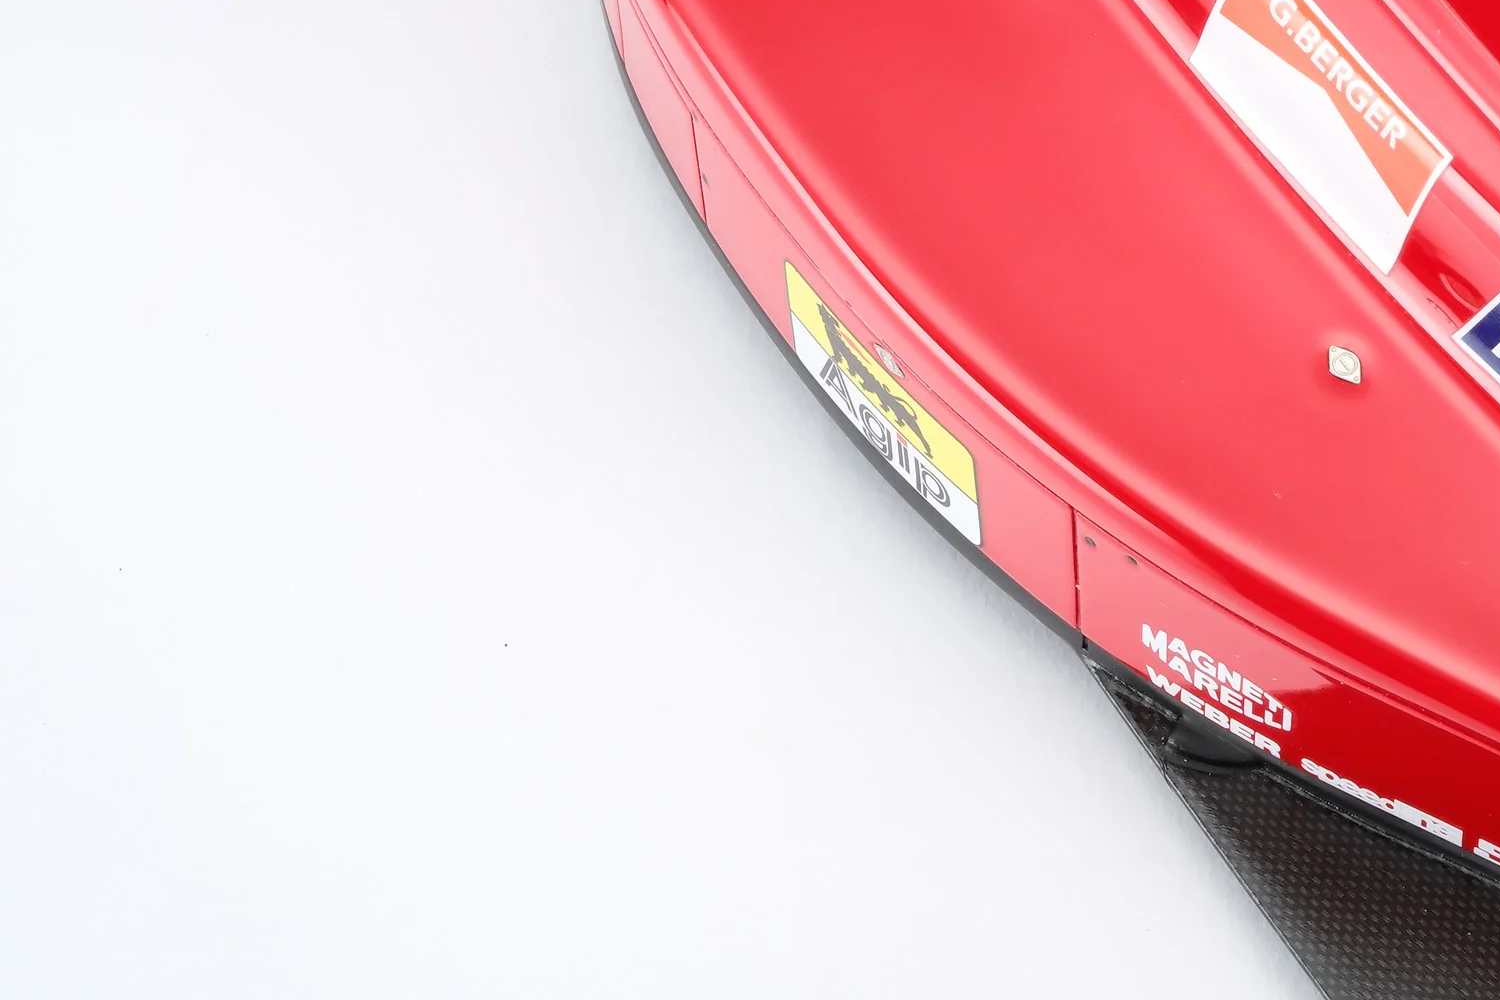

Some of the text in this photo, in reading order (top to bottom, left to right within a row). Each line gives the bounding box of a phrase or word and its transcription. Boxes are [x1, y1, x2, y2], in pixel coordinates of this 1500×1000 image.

[819, 357, 952, 508] Agip
[1141, 623, 1293, 732] MAGNETI
[1146, 665, 1282, 760] WEBER
